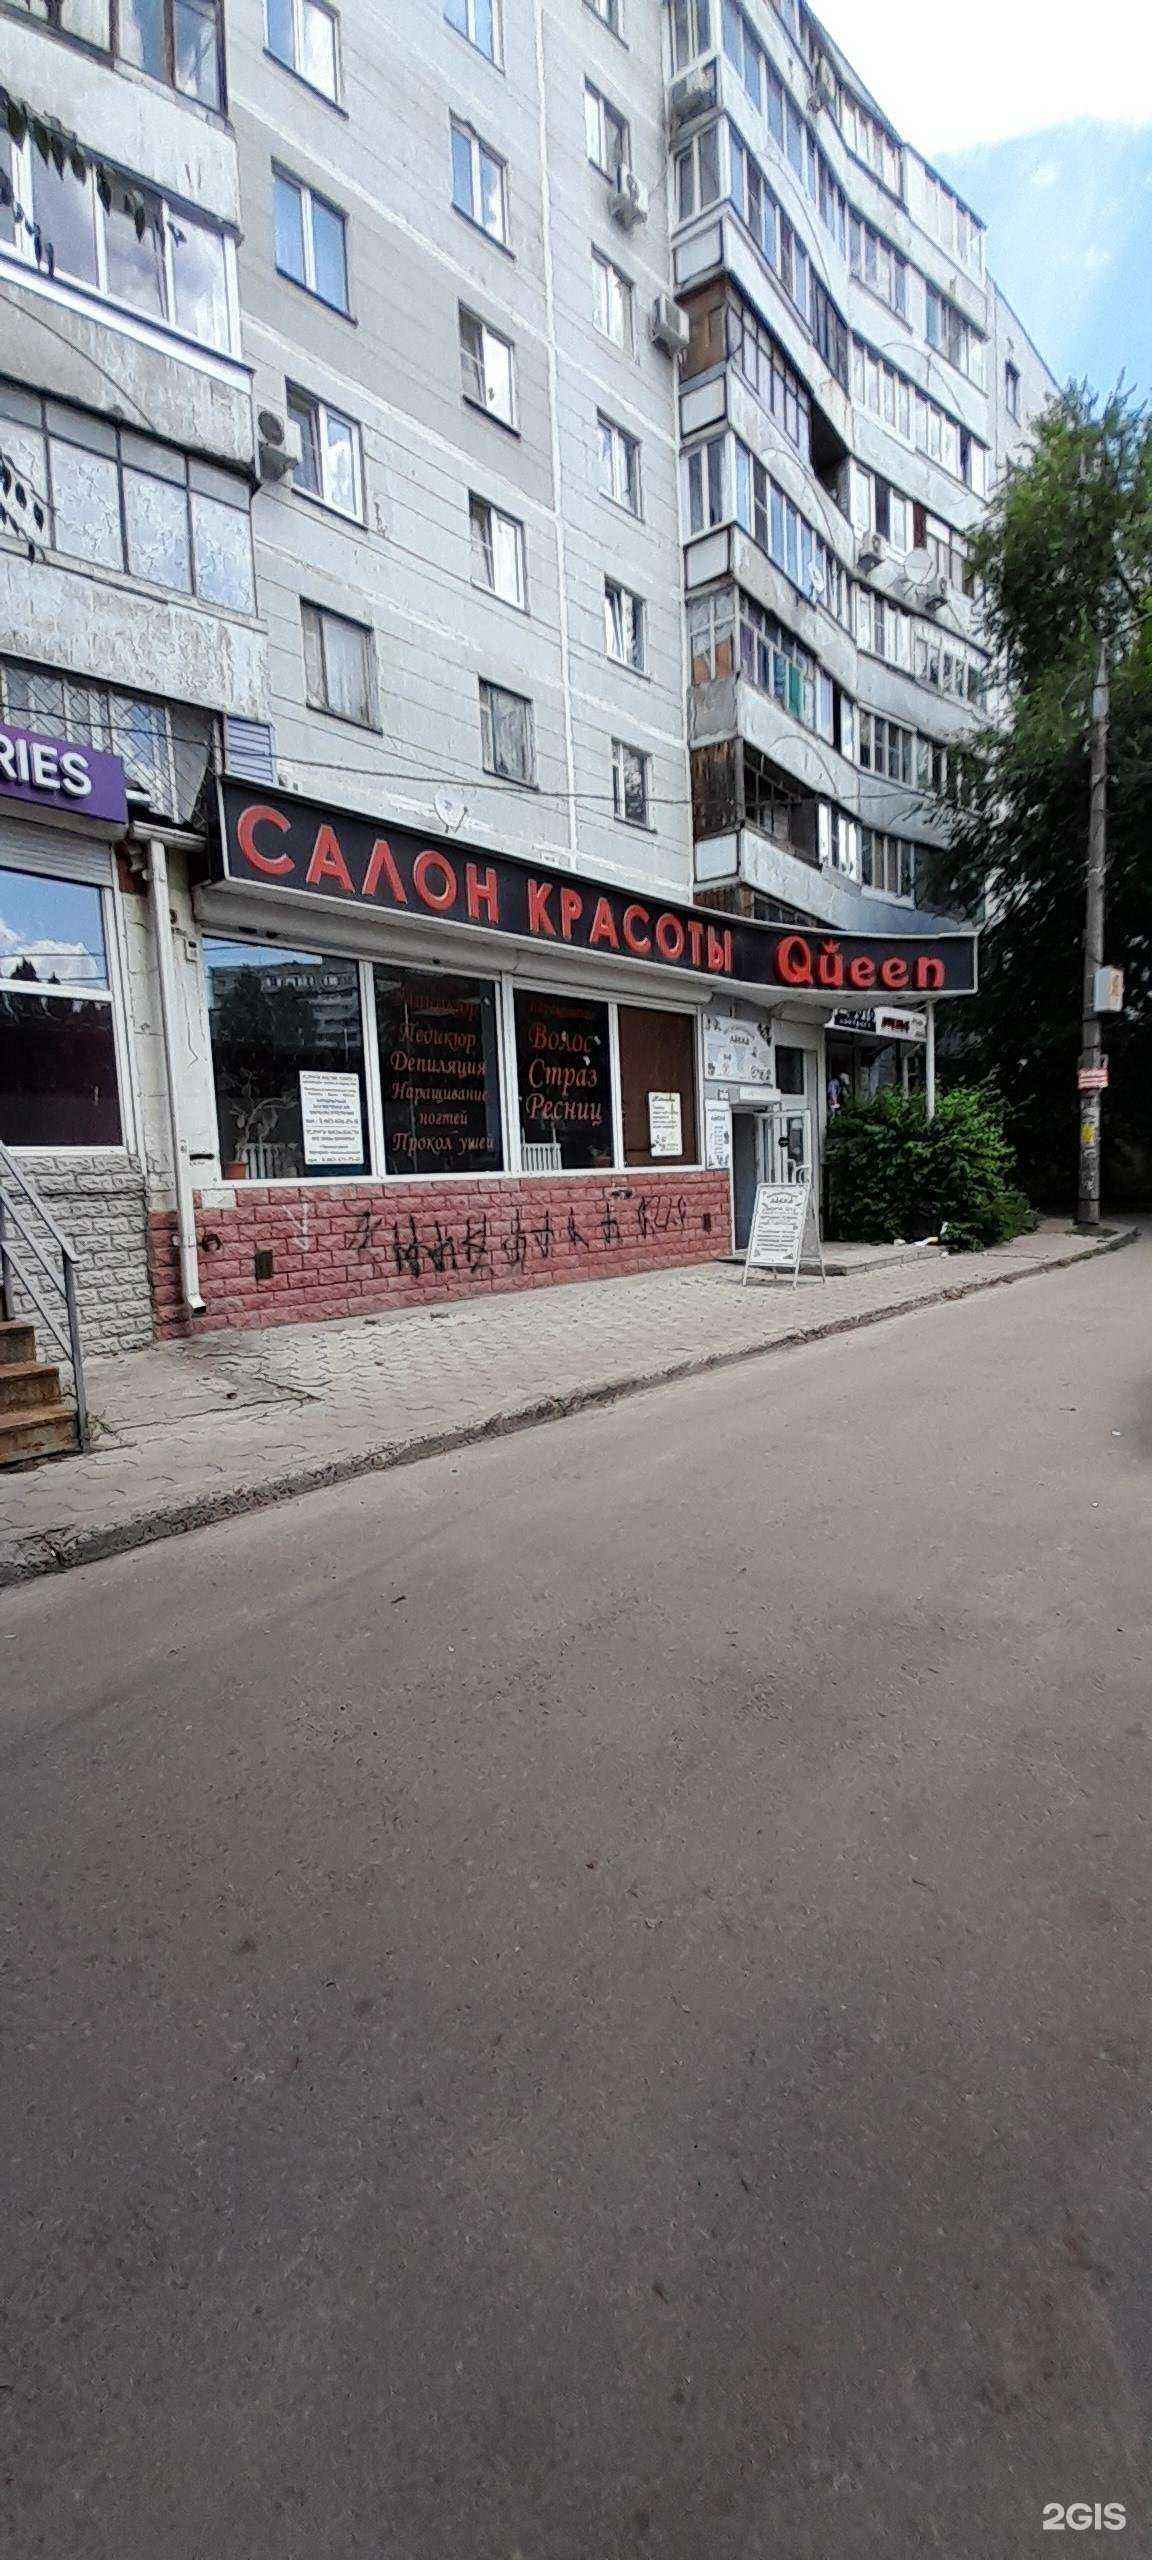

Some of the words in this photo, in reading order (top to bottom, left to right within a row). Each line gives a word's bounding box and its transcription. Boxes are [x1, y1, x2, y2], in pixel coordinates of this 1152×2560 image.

[0, 733, 92, 798] RIES
[237, 804, 499, 925] САЛОН
[527, 878, 733, 973] КРАСОТЫ
[774, 934, 946, 990] Queen
[528, 1022, 594, 1053] Волос
[390, 1050, 488, 1080] Депиляция
[528, 1059, 598, 1096] Страз
[391, 1081, 488, 1105] Наращивание
[419, 1109, 470, 1126] ногтей
[526, 1093, 602, 1127] Ресниц
[391, 1132, 453, 1157] Прокол
